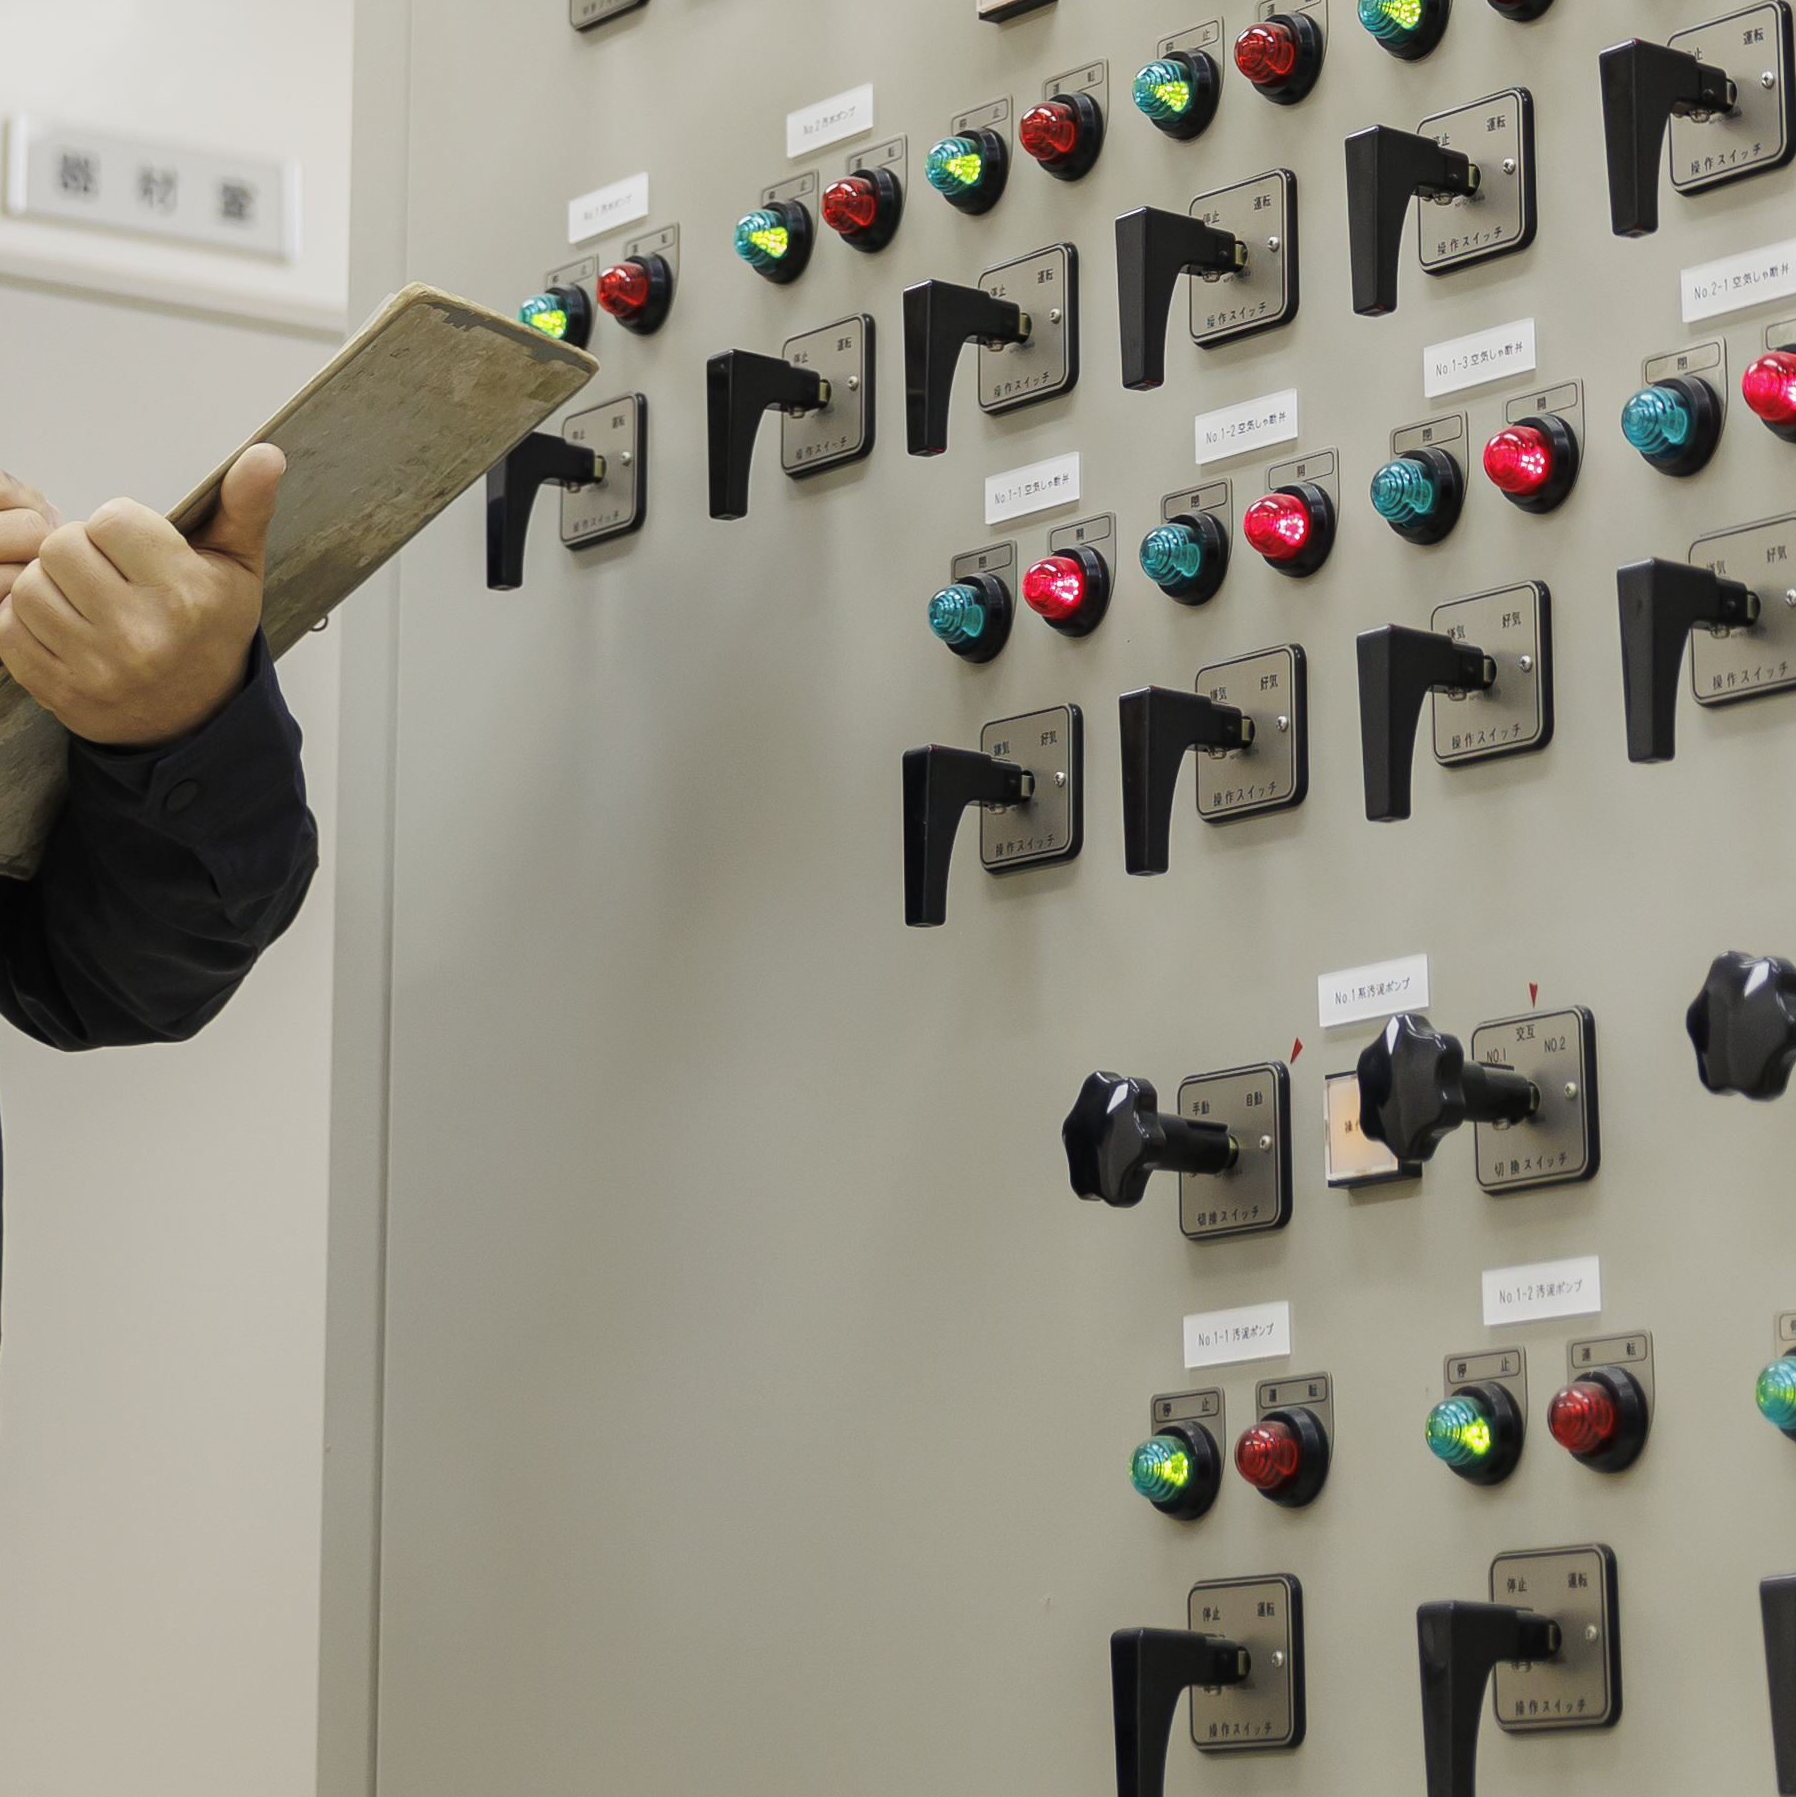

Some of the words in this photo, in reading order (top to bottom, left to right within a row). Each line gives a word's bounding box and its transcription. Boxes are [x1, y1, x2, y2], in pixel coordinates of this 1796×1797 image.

[1743, 27, 1764, 46] 運転
[1486, 115, 1507, 133] 運転
[1690, 142, 1762, 175] 操作スイッチ
[1253, 194, 1272, 212] 運転
[1437, 225, 1503, 256] 操作スイッチ
[1694, 278, 1729, 301] No.2-1
[1206, 301, 1267, 329] 操作スイッチ
[1436, 355, 1468, 377] No.1-3
[1206, 424, 1236, 445] No.1-2
[1766, 545, 1788, 563] 好気
[1502, 611, 1521, 630] 好気
[1260, 674, 1279, 691] 好気
[1712, 661, 1789, 691] 操作スイッチ
[1452, 723, 1522, 751] 操作スイッチ
[1213, 781, 1277, 809] 操作スイッチ
[1516, 1024, 1536, 1043] 交互
[1544, 1035, 1567, 1054] NO.2
[1486, 1047, 1508, 1065] NO.1
[1192, 1099, 1211, 1117] 手動
[1245, 1090, 1264, 1108] 自動
[1494, 1152, 1568, 1179] 切換スイッチ
[1197, 1205, 1260, 1228] 切換スイッチ
[1498, 1284, 1533, 1305] No.1-2
[1536, 1278, 1582, 1301] 汚泥ポンプ
[1198, 1327, 1229, 1348] No.1-1
[1507, 1577, 1527, 1594] 停止
[1567, 1572, 1588, 1590] 運転
[1202, 1605, 1221, 1623] 停止
[1257, 1601, 1275, 1619] 運転
[1515, 1698, 1586, 1718] 操作スイッチ
